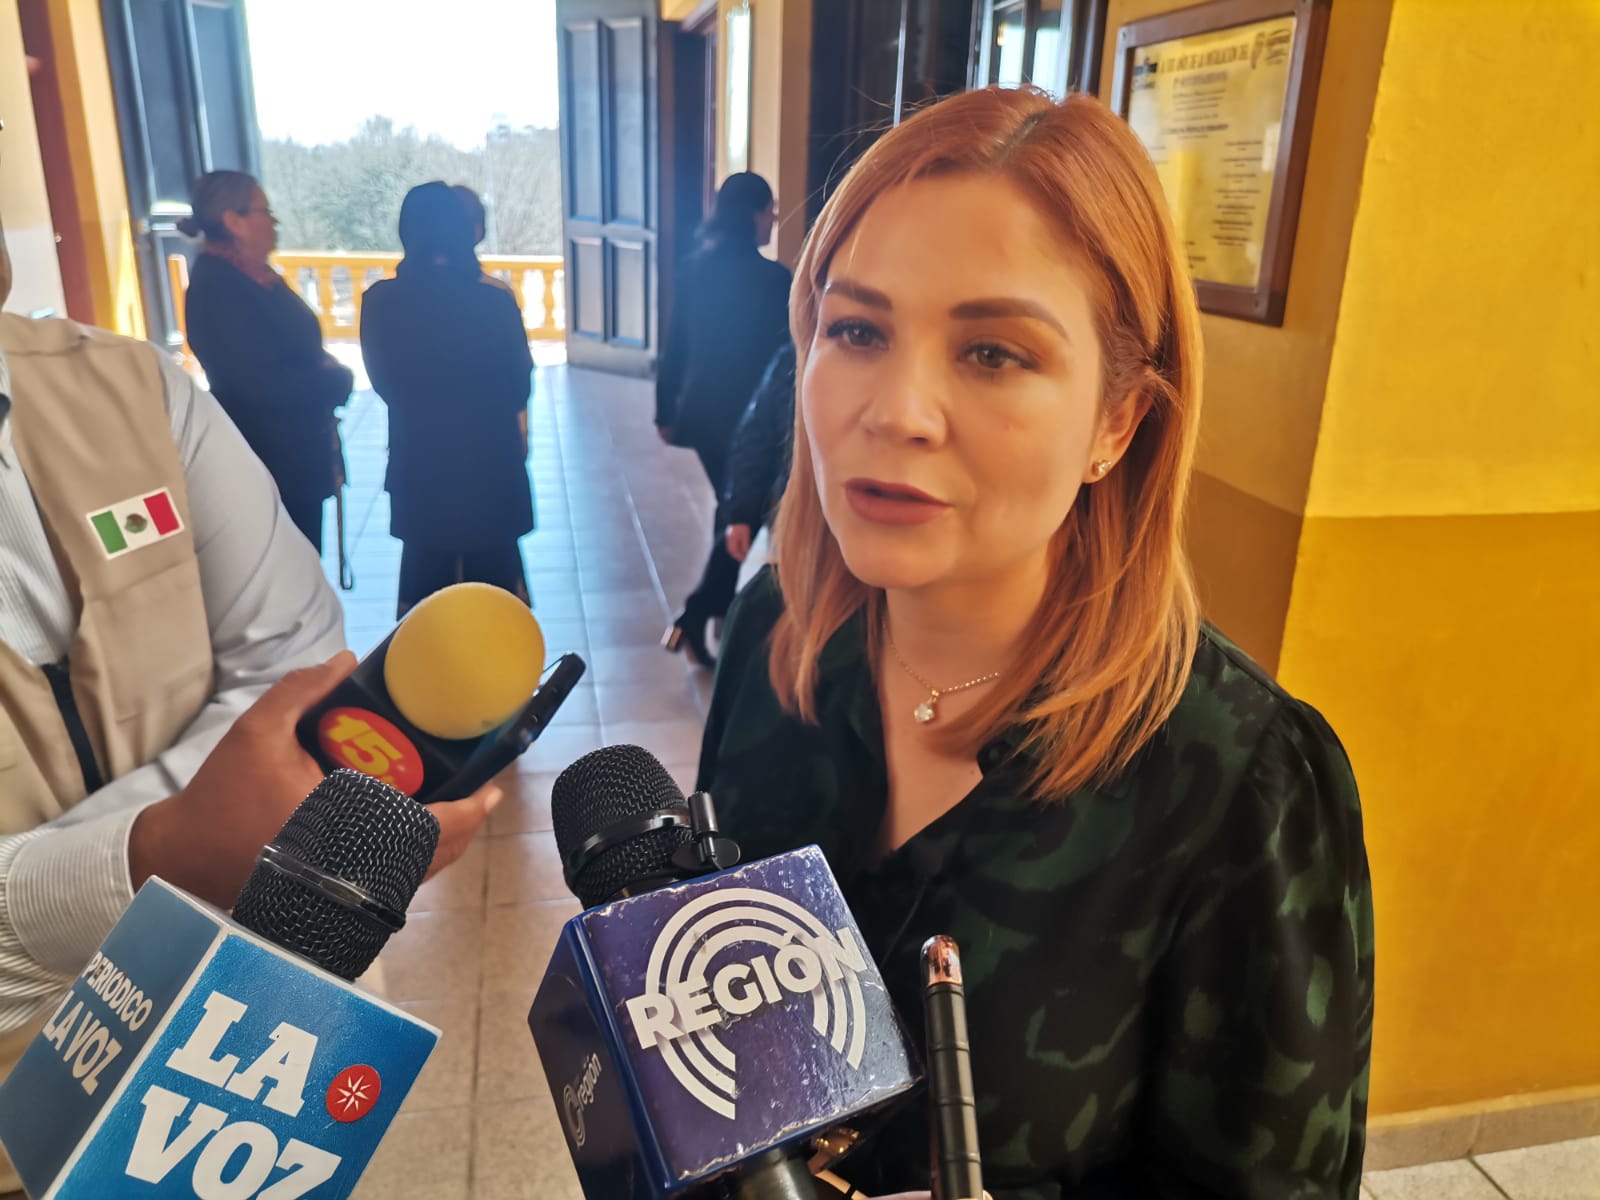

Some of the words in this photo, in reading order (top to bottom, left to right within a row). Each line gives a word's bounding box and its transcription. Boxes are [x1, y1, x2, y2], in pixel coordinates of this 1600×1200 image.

[42, 990, 84, 1051] LA
[63, 1011, 123, 1096] VOZ
[82, 951, 154, 1032] PERIÓDICO
[626, 927, 868, 1050] REGIÓN
[165, 990, 319, 1118] LA
[125, 1084, 342, 1200] VOZ
